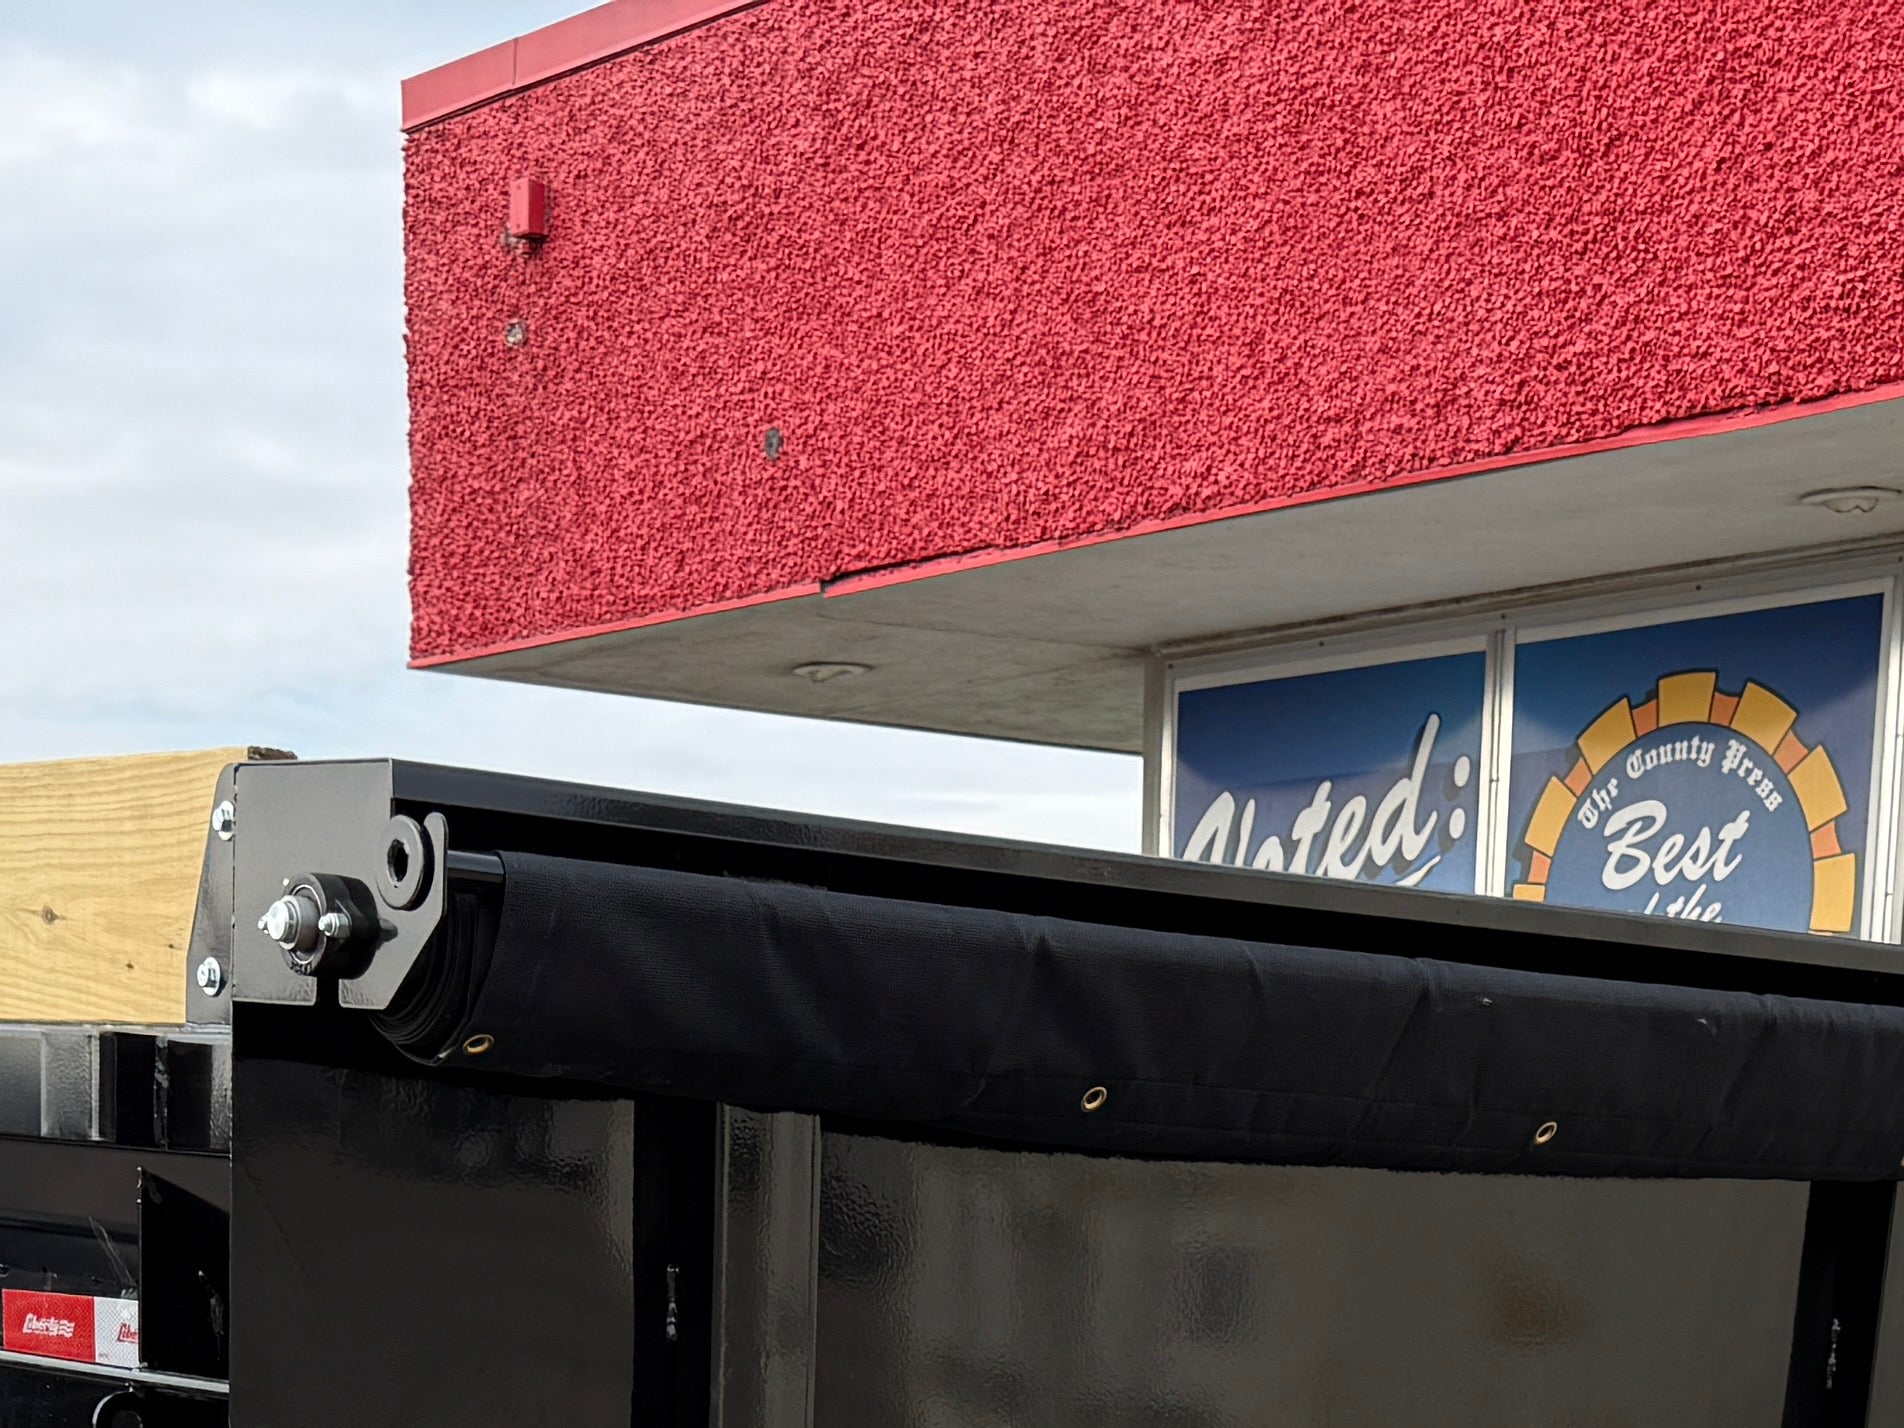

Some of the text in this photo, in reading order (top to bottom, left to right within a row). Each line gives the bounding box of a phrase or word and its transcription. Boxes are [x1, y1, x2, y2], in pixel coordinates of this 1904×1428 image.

[1577, 735, 1783, 829] The County Press
[1602, 799, 1750, 890] Best
